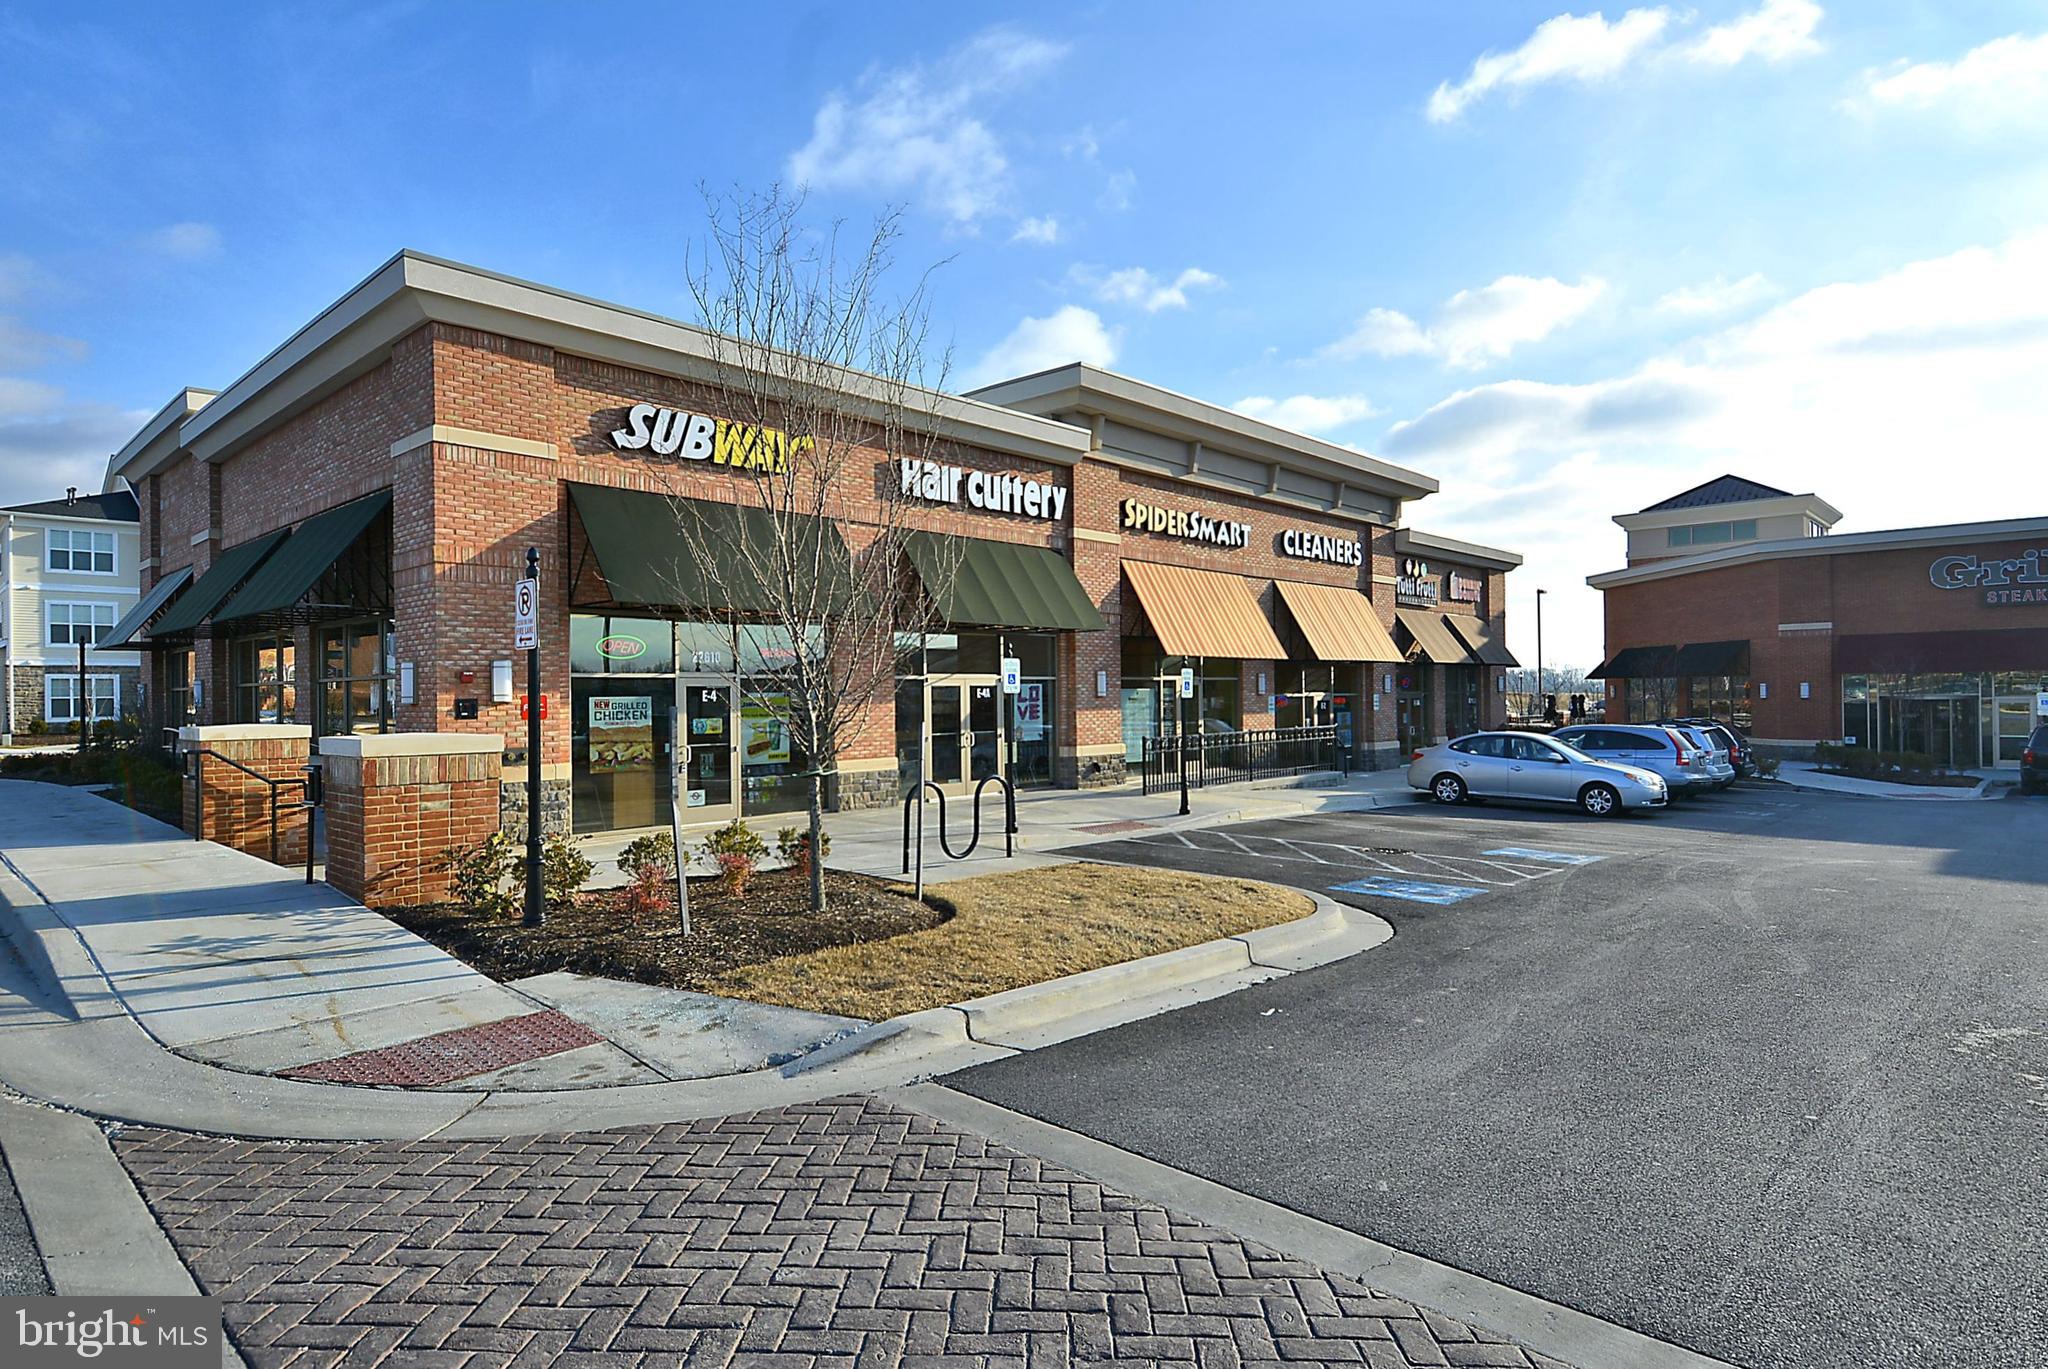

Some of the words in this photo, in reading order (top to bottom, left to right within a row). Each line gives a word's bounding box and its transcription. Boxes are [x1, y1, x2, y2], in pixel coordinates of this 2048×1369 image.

[611, 403, 814, 473] SUBWAY
[901, 458, 962, 503] Hair
[1124, 498, 1251, 547] SPIDERSMART
[1284, 529, 1362, 566] CLEANERS
[1929, 549, 2048, 589] Gri
[1396, 576, 1415, 595] Tutti
[603, 639, 640, 654] OPEN
[594, 700, 610, 709] NEW
[612, 701, 648, 710] GRILLED
[702, 690, 717, 702] E-4
[594, 710, 648, 721] CHICKEN
